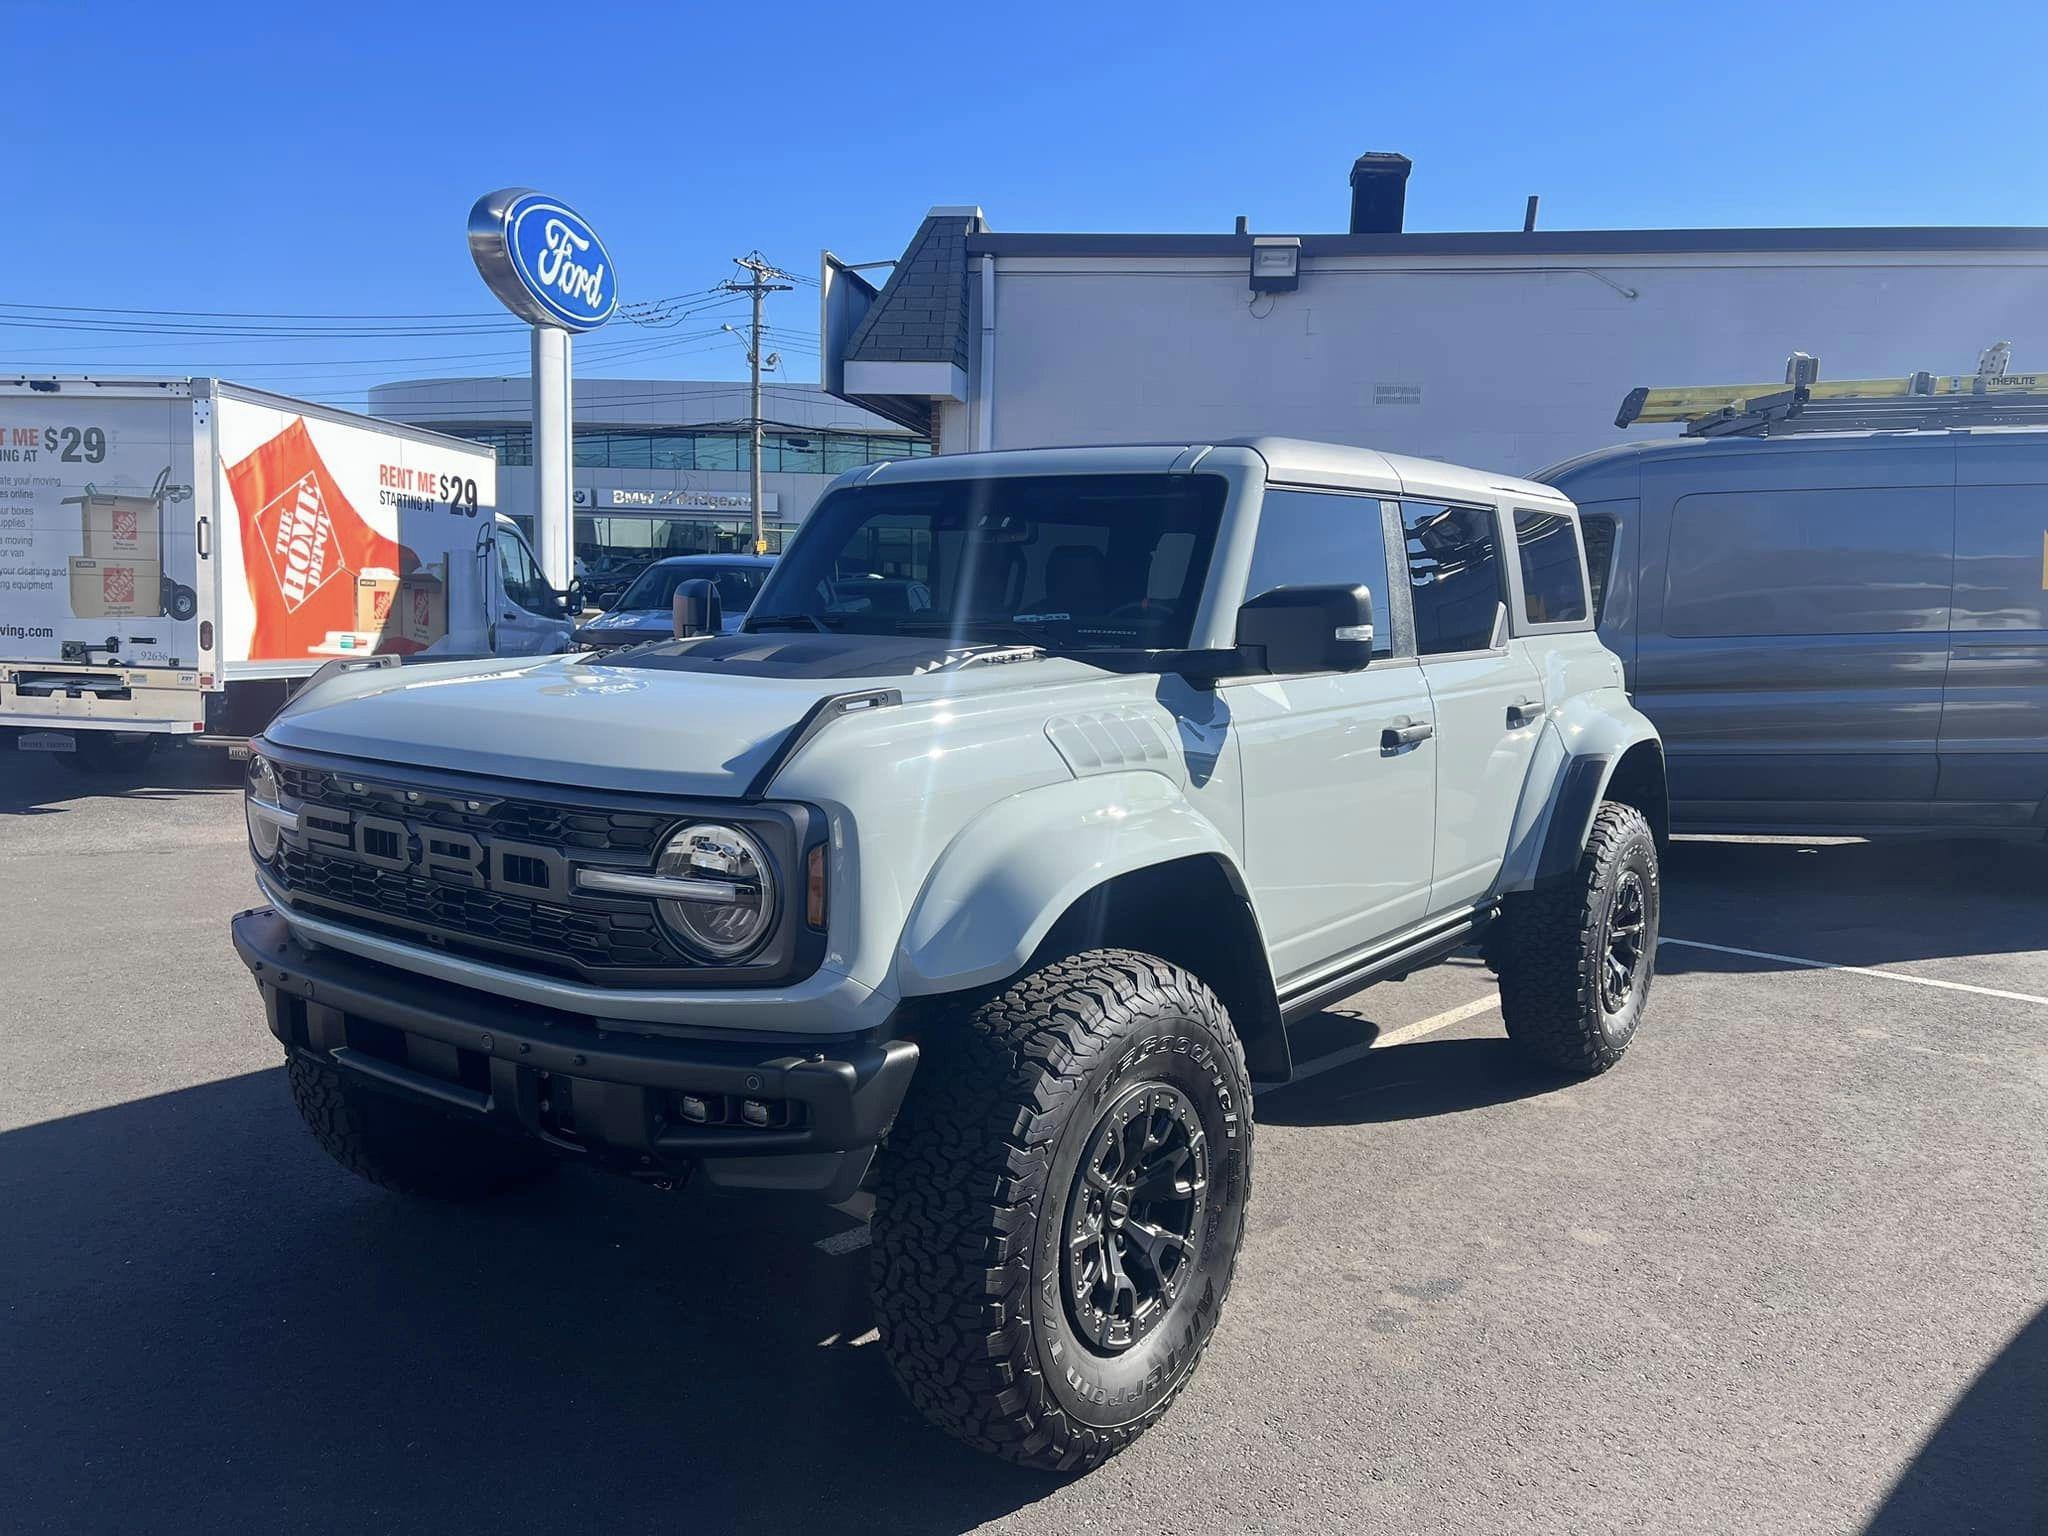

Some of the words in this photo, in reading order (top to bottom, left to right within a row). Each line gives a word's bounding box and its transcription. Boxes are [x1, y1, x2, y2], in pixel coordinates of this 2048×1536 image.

[538, 218, 604, 309] Ford
[13, 428, 39, 446] ME
[44, 426, 106, 463] $29
[23, 449, 38, 462] AT
[32, 476, 62, 488] moving
[380, 464, 414, 490] RENT
[418, 471, 436, 494] ME
[440, 472, 478, 518] $29
[380, 490, 422, 511] STARTING
[425, 498, 435, 512] AT
[613, 489, 654, 505] BMW
[11, 505, 34, 515] boxes
[275, 508, 294, 555] THE
[282, 479, 321, 603] HOME
[5, 536, 33, 547] moving
[308, 510, 330, 588] DEPOT
[10, 549, 25, 558] van
[52, 567, 67, 577] and
[12, 580, 54, 592] equipment
[299, 801, 570, 905] FORD
